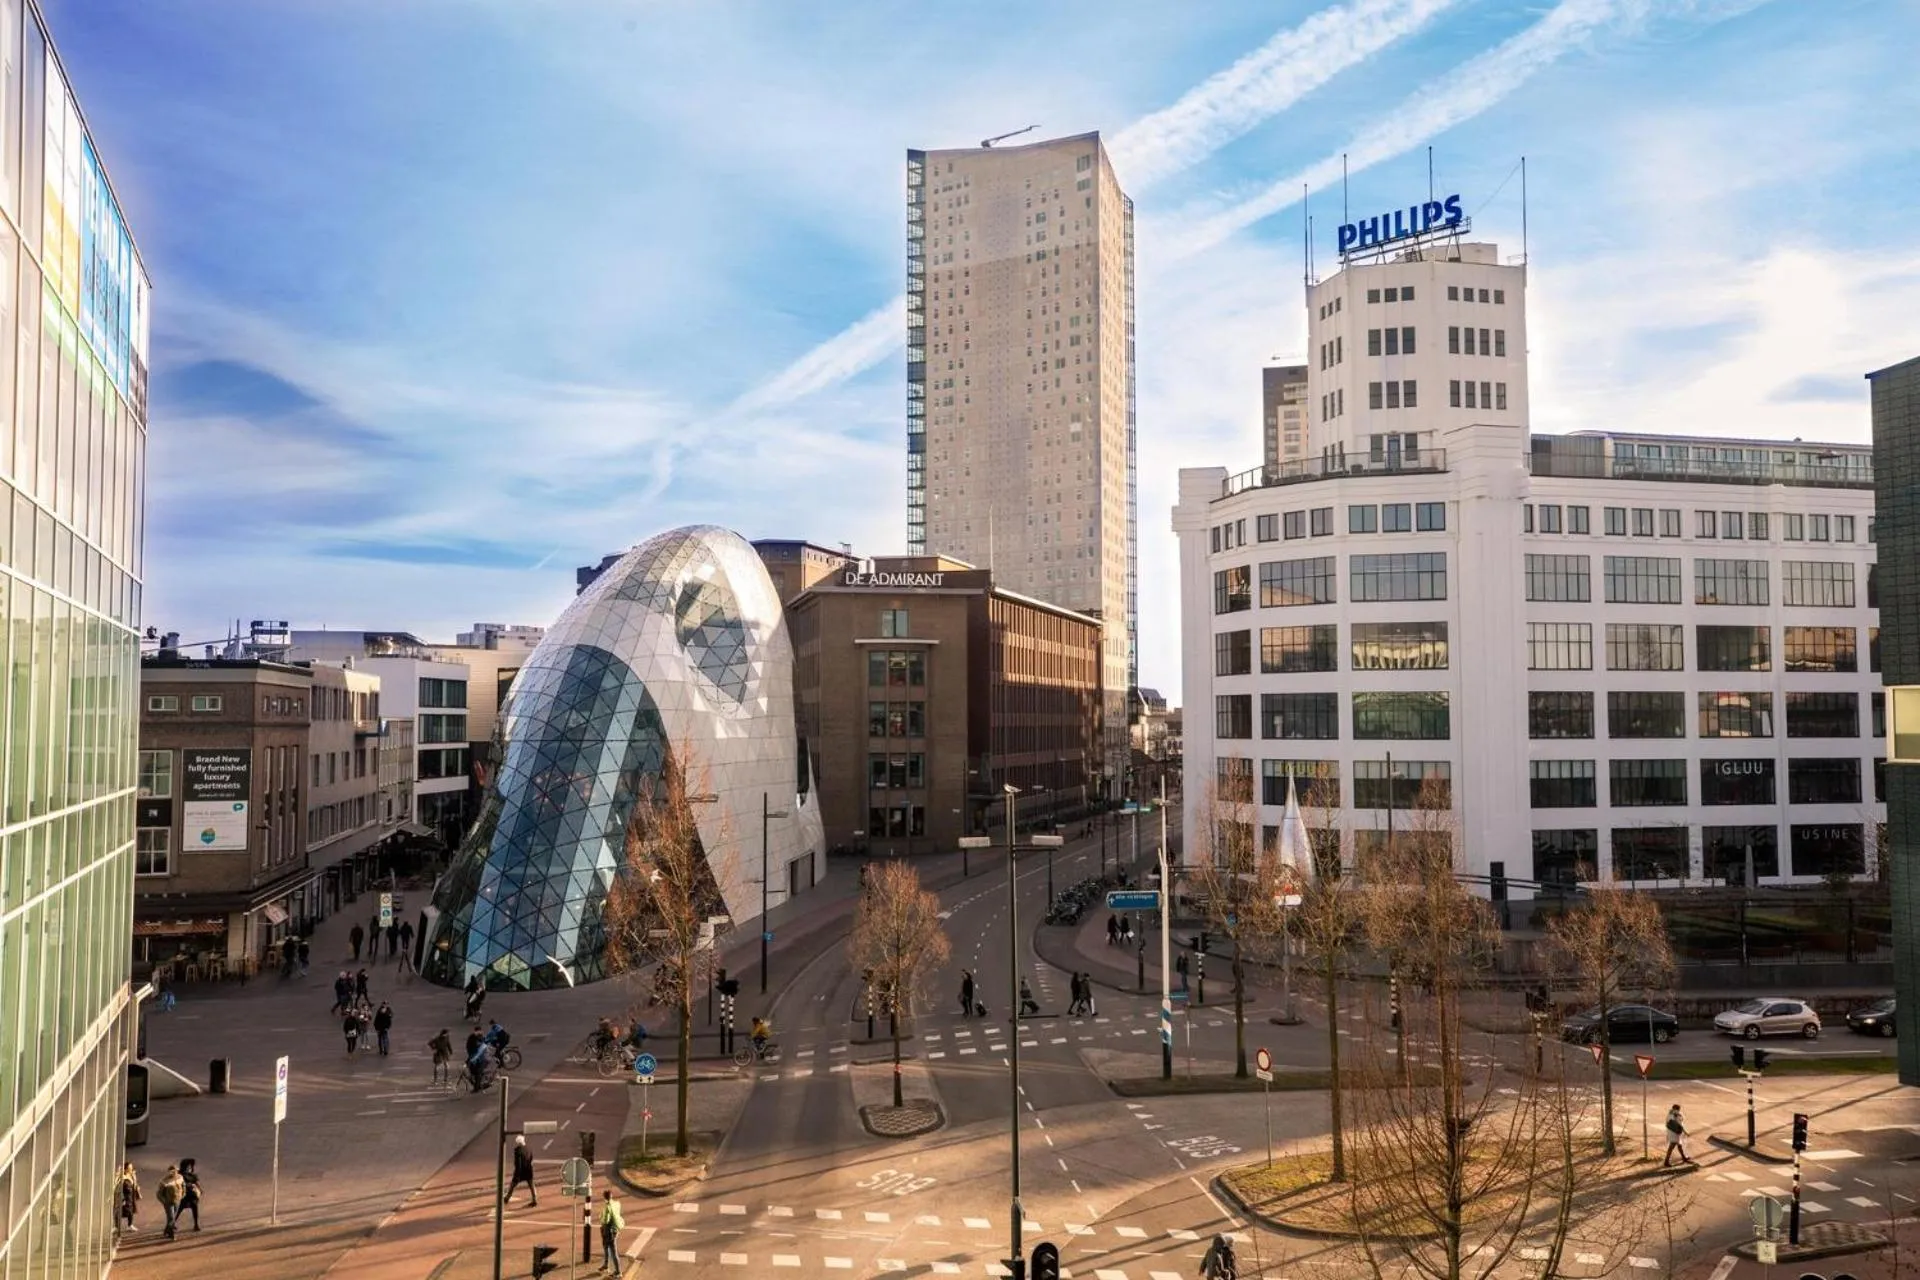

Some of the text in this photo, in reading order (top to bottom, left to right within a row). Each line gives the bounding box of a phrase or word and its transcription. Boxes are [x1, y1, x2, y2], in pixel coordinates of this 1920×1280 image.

[1338, 194, 1463, 254] PHILIPS
[846, 572, 945, 586] DE ADMIRANT
[195, 755, 240, 763] Brand New
[188, 764, 247, 773] fully furnished
[1715, 761, 1763, 775] IGLUU
[204, 773, 231, 782] luxury
[192, 782, 241, 790] apartments
[1801, 828, 1850, 840] USINE
[855, 1169, 937, 1195] BUS
